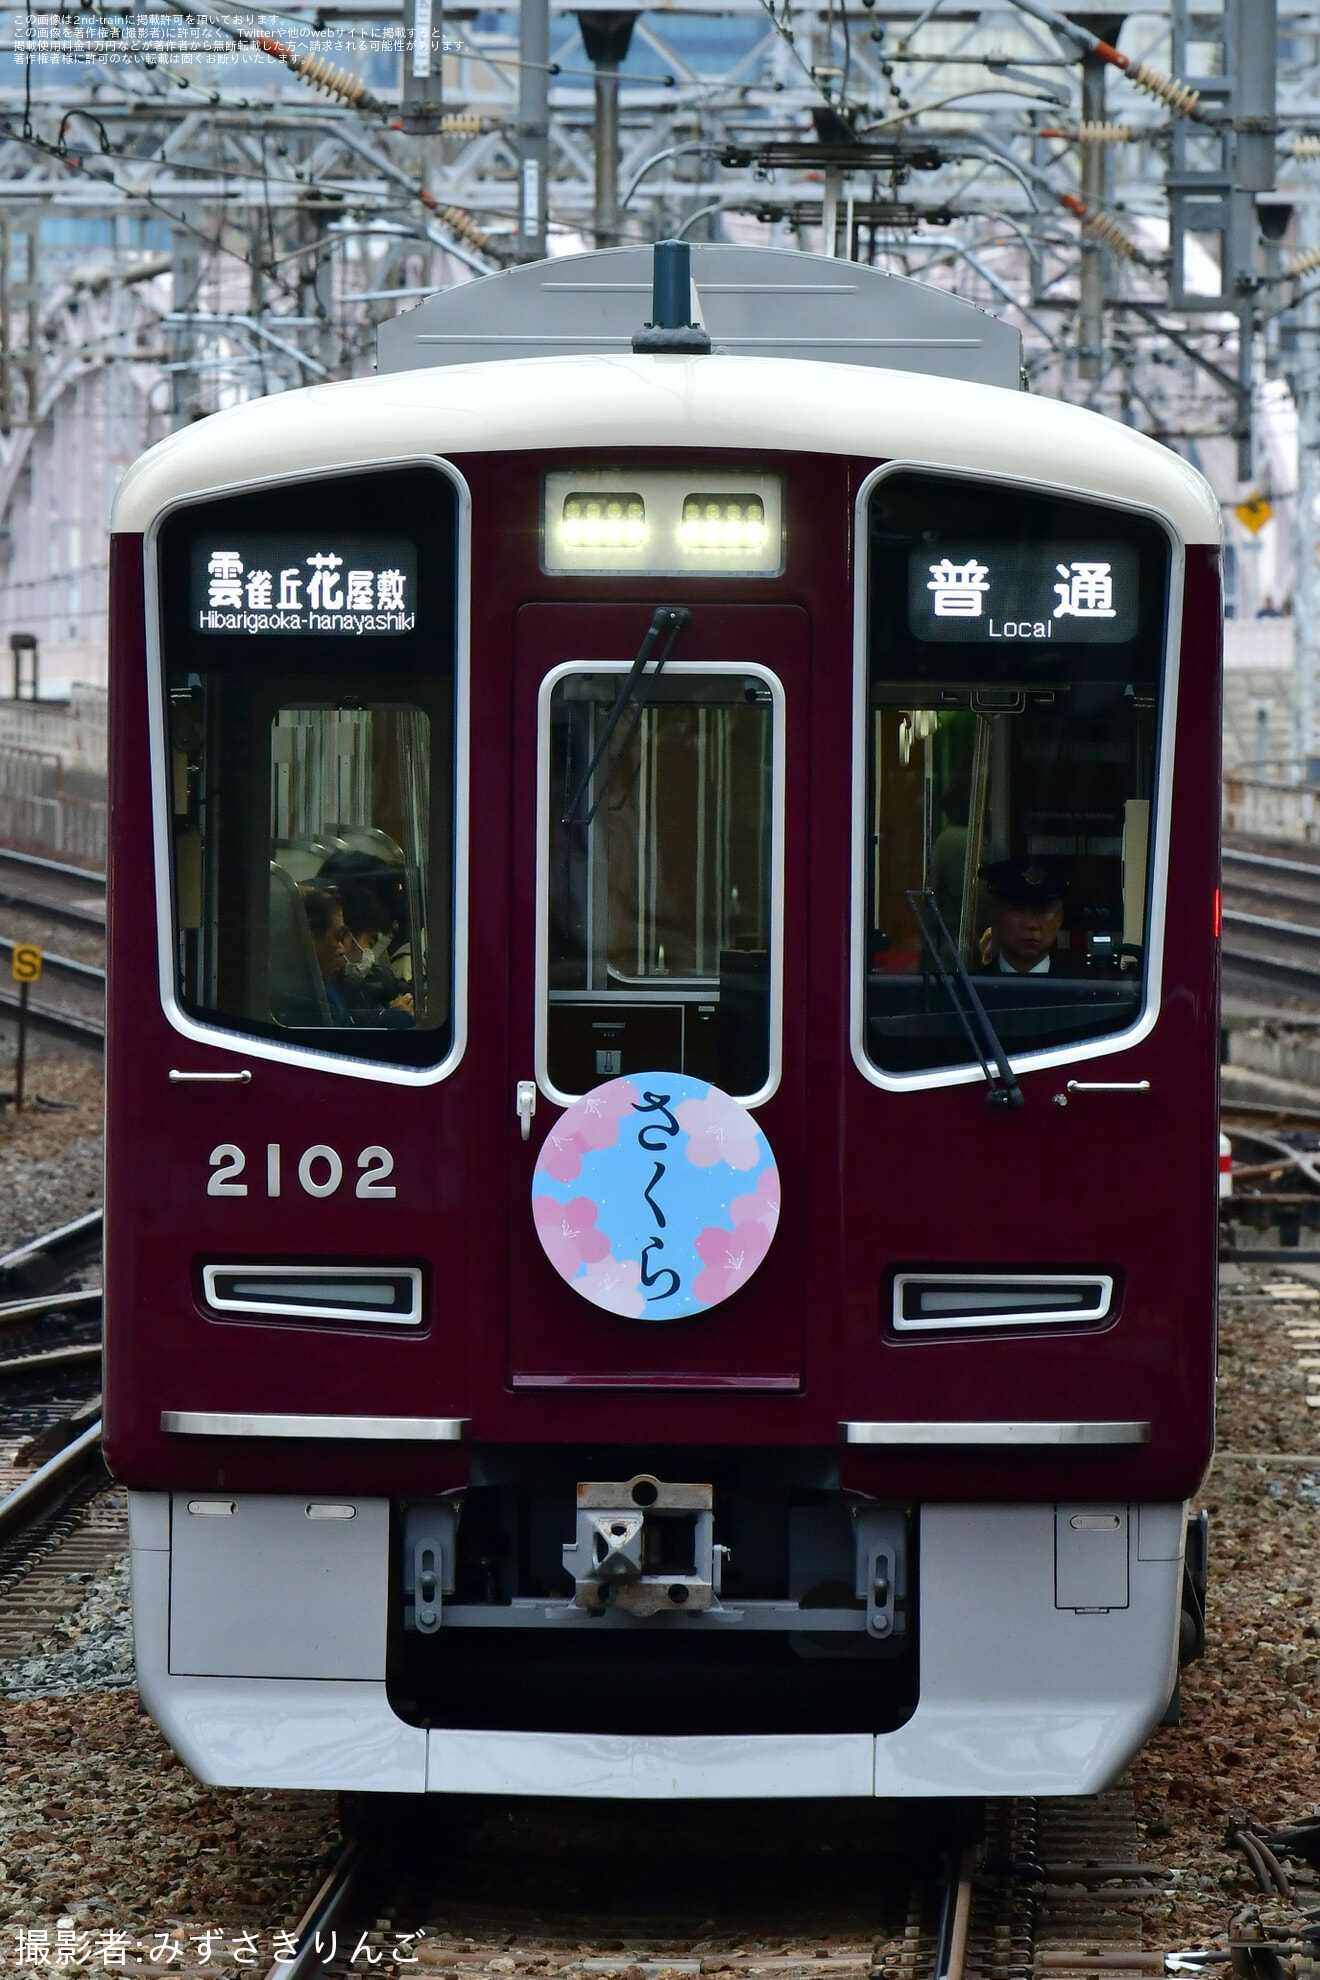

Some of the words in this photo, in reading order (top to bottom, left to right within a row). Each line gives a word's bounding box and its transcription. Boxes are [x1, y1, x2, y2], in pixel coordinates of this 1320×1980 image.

[207, 551, 406, 610] 雲雀丘花屋敷
[199, 610, 415, 635] Hibarigaoka-hanayashiki
[988, 618, 1052, 638] Local
[17, 949, 38, 978] S
[206, 1143, 397, 1199] 2102
[631, 1090, 681, 1302] さくら
